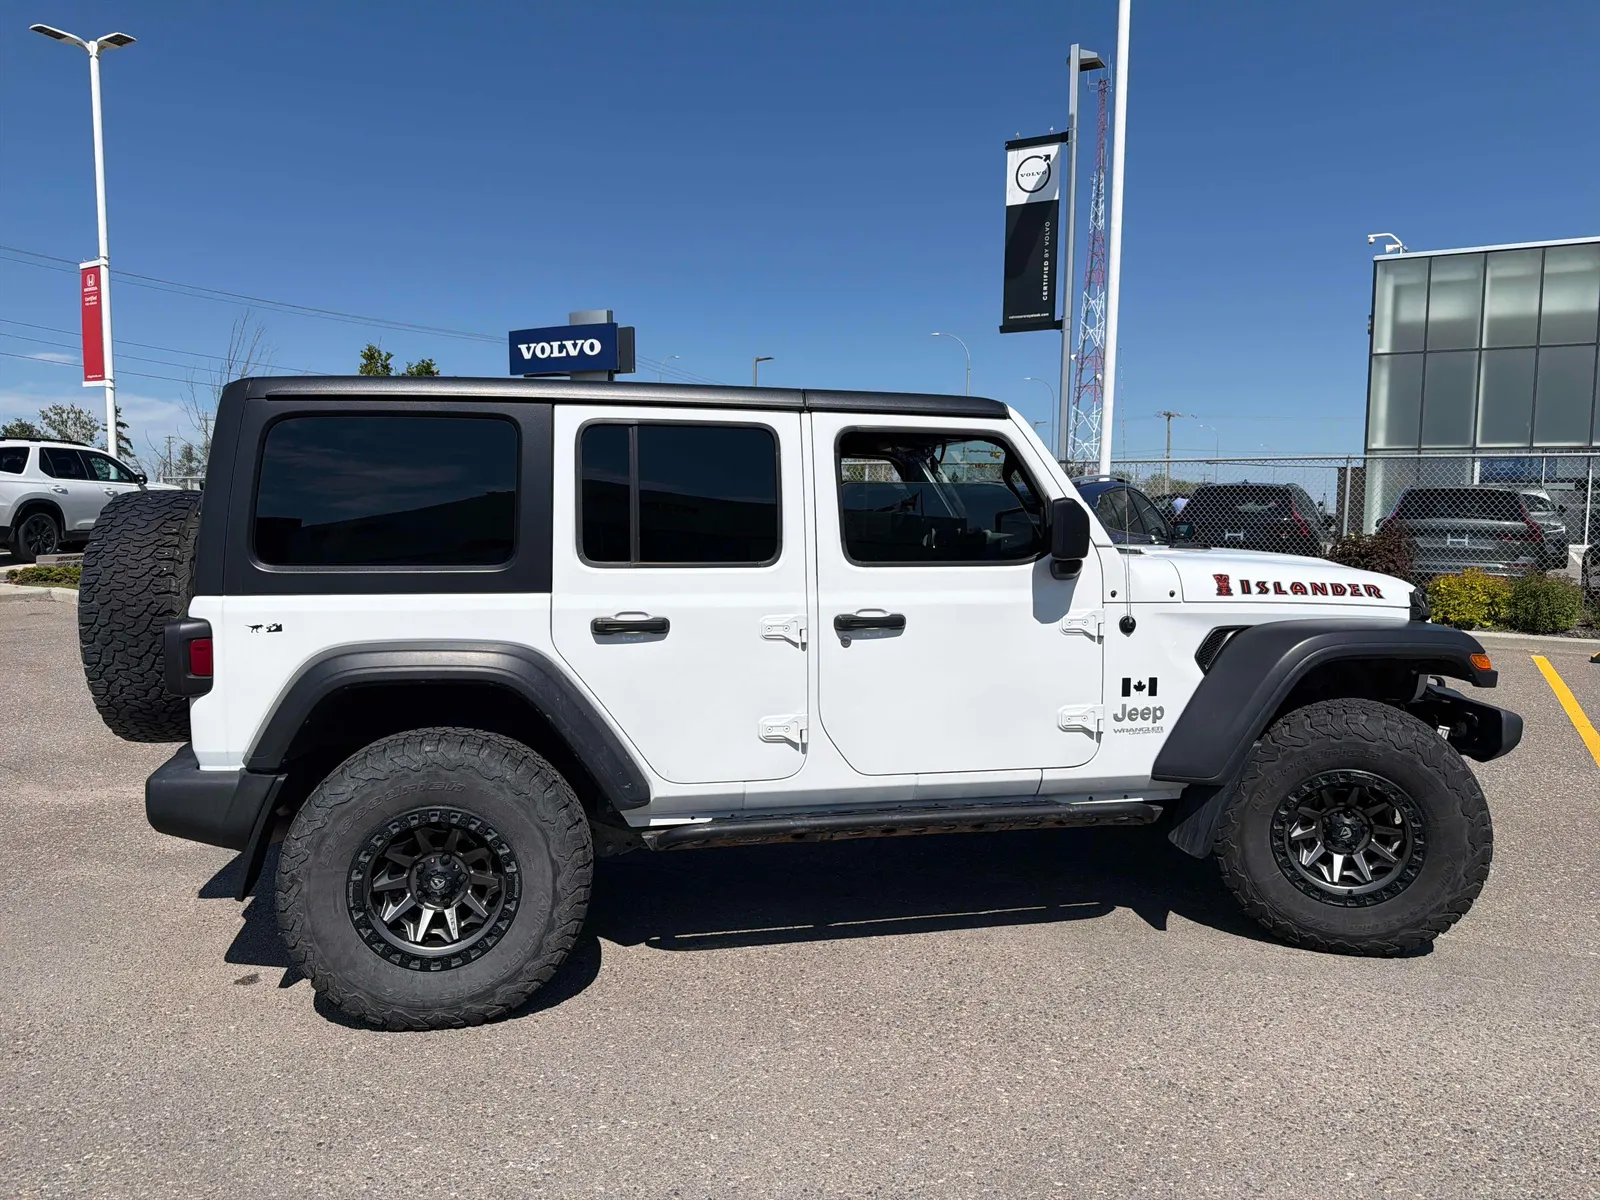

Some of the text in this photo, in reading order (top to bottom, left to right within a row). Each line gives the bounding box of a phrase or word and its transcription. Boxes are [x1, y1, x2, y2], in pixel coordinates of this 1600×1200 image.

[1020, 170, 1047, 178] VOLVO
[1043, 248, 1050, 258] BY
[518, 338, 602, 360] VOLVO
[1239, 579, 1386, 600] ISLANDER
[1112, 703, 1165, 724] Jeep
[1112, 726, 1164, 734] WRANGLER
